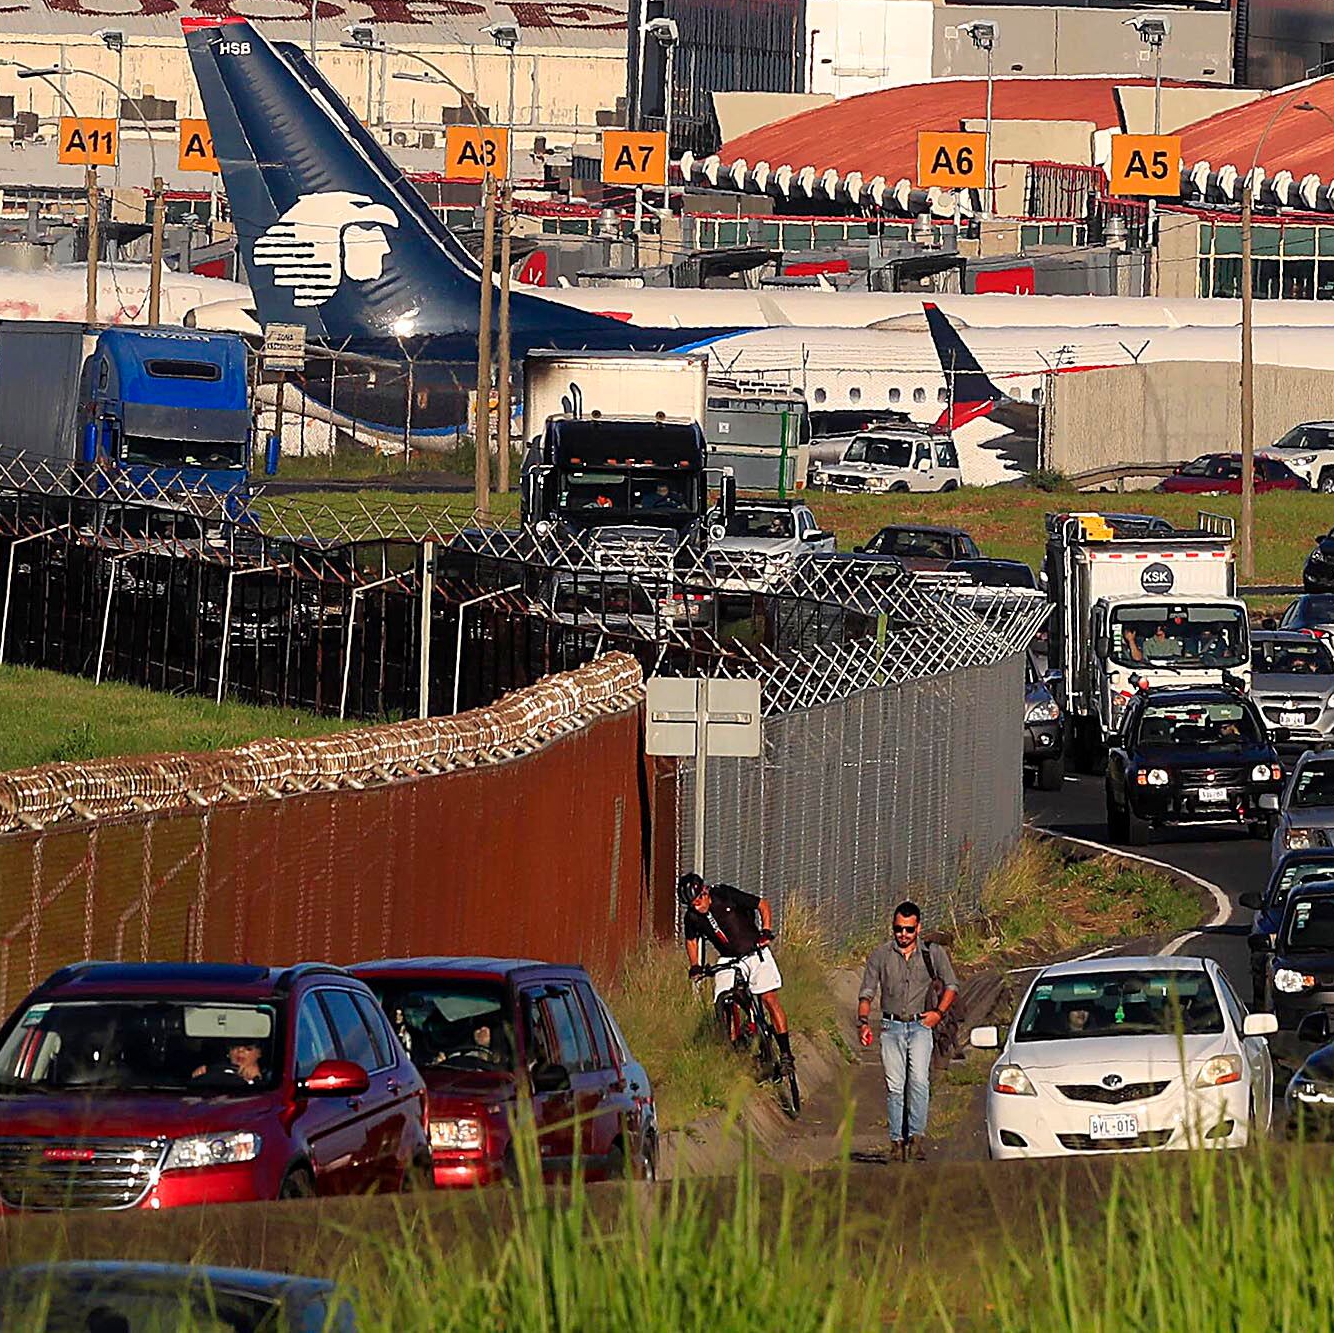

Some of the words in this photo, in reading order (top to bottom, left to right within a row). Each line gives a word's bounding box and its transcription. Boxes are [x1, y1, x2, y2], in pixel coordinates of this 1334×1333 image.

[219, 41, 251, 56] HSB
[65, 129, 112, 154] A11
[457, 140, 496, 167] A8
[614, 145, 654, 172] A7
[931, 146, 974, 175] A6
[1124, 150, 1168, 179] A5
[1143, 571, 1168, 582] KSK
